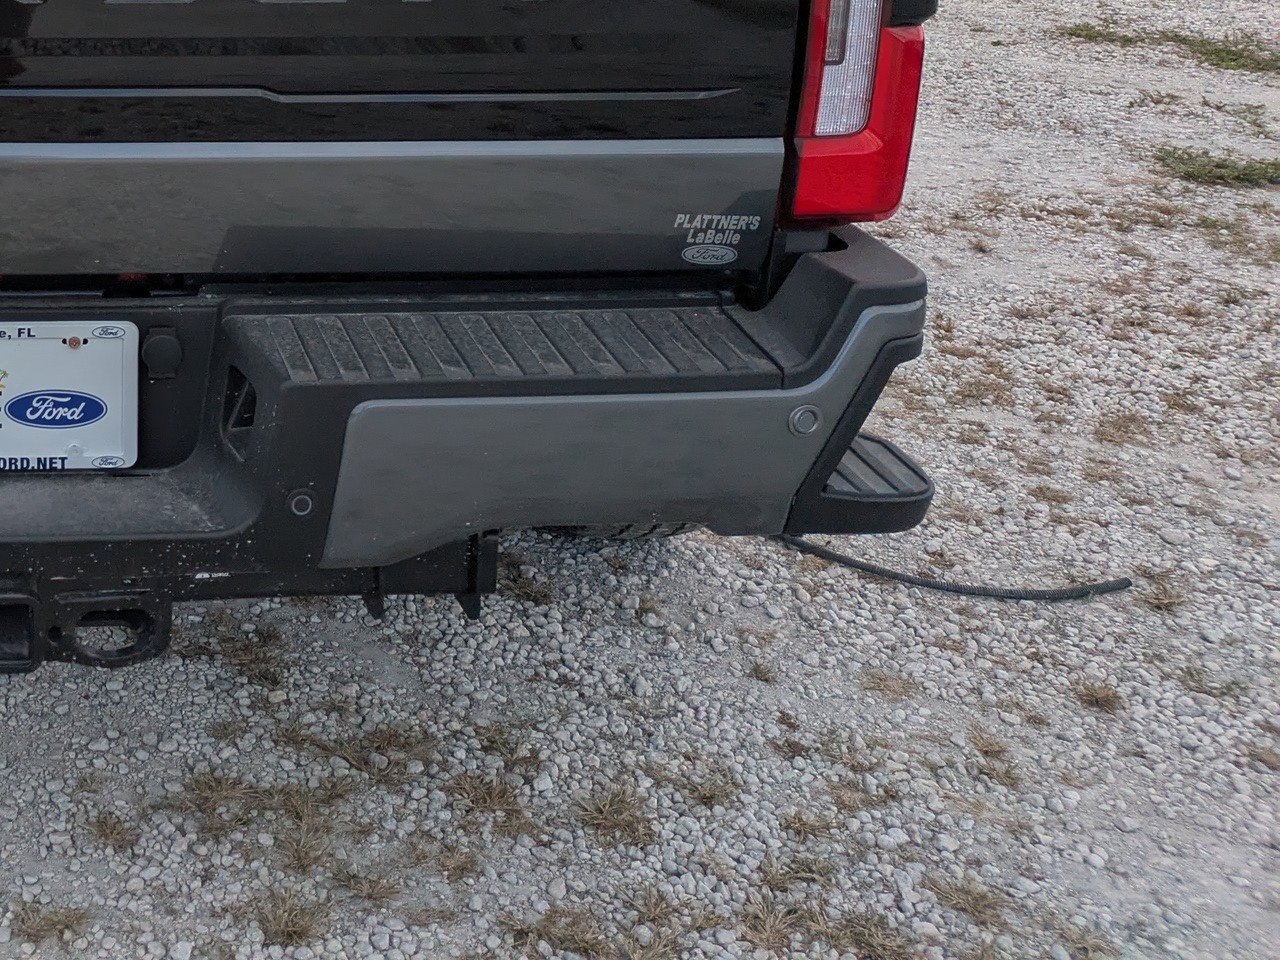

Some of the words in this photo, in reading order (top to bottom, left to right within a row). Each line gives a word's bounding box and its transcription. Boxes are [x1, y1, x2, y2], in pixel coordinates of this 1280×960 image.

[673, 214, 761, 230] PLATTNER'S
[686, 229, 741, 244] LaBelle
[17, 327, 36, 338] FL
[25, 395, 86, 422] Ford
